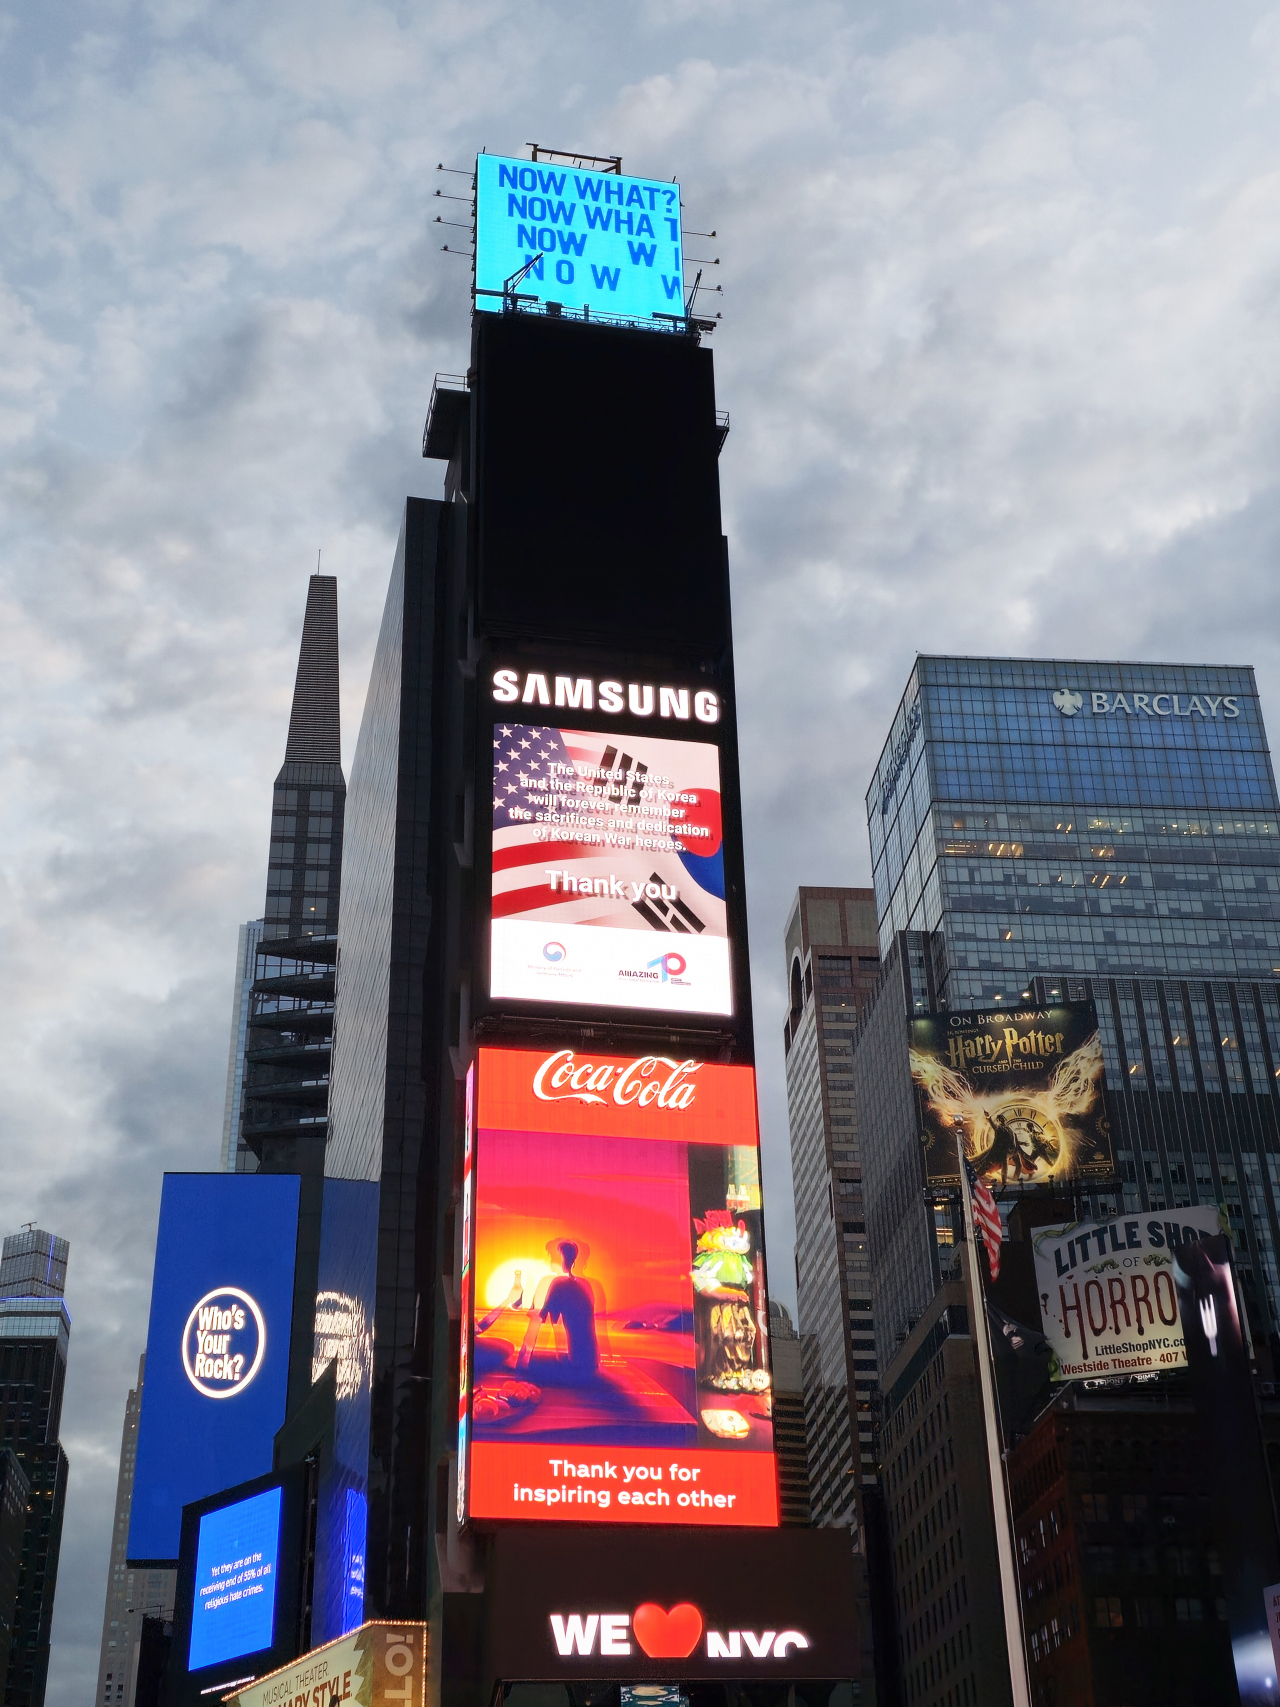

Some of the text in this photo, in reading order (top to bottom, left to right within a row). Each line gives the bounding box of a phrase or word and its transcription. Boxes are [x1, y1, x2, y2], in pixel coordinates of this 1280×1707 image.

[499, 164, 677, 213] NOW WHAT?
[508, 193, 576, 225] NOW
[517, 224, 587, 256] NOW
[492, 669, 720, 722] SAMSUNG
[1091, 692, 1240, 718] BARCLAYS
[547, 762, 669, 785] The United States
[520, 777, 697, 803] and the Republic of Korea
[533, 794, 685, 818] will forever remember
[508, 806, 709, 837] the sacrifices and dedication
[532, 826, 687, 851] of Korean War heroes.
[545, 869, 676, 902] Thank you
[945, 1027, 1064, 1069] Harry Potter
[532, 1050, 704, 1109] Coca-Cola
[972, 1061, 1044, 1074] CURSED CHILD
[1054, 1221, 1142, 1277] LITTLE
[1122, 1257, 1140, 1268] OF
[199, 1304, 245, 1330] Who's
[197, 1331, 230, 1355] Your
[194, 1354, 244, 1381] Rock?
[1061, 1360, 1109, 1375] Westside
[1111, 1356, 1152, 1370] Theatre
[1159, 1351, 1179, 1364] 407
[549, 1460, 701, 1483] Thank you for
[514, 1484, 736, 1508] inspiring each other
[211, 1552, 262, 1577] Yet they are on the
[200, 1563, 271, 1596] receiving end of 55% of all
[205, 1584, 263, 1610] religious hate crimes.
[550, 1614, 632, 1656] WE
[262, 1679, 293, 1707] MUSICAL
[295, 1661, 329, 1691] THEATER.
